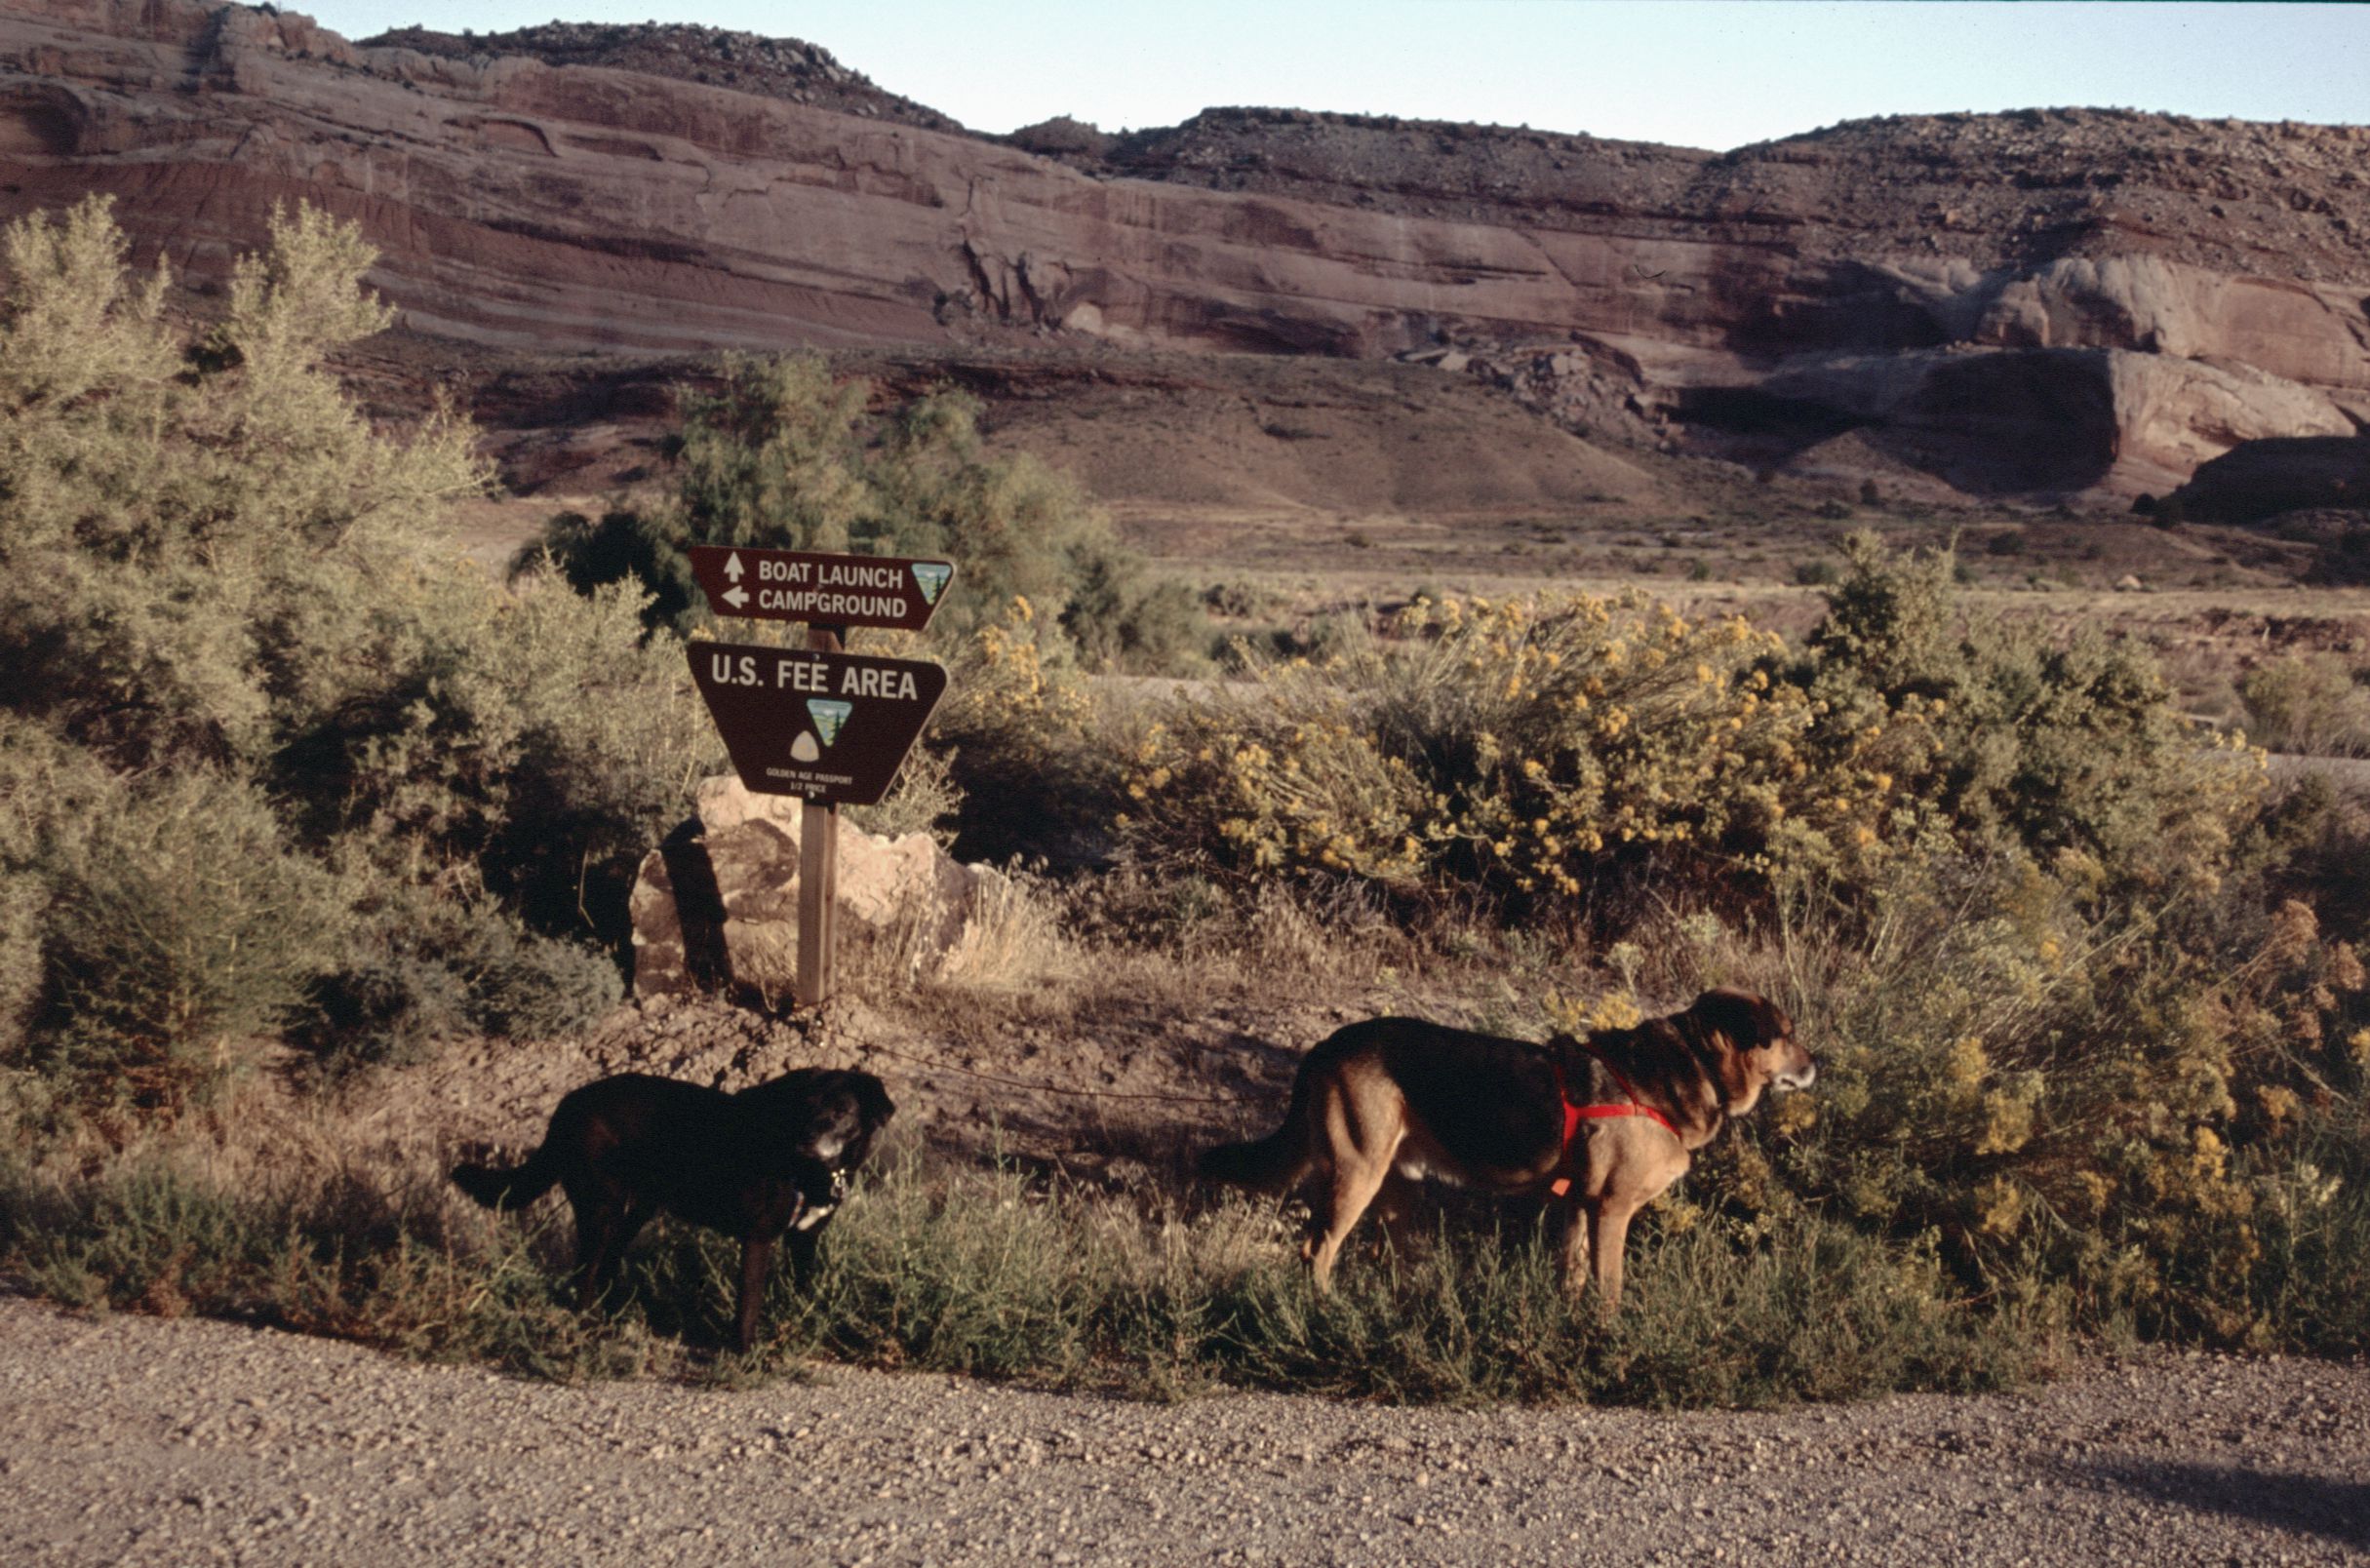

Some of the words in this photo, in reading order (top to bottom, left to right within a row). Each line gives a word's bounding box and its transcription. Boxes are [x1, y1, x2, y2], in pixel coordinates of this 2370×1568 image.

[759, 560, 811, 582] BOAT
[818, 565, 903, 589] LAUNCH
[759, 589, 907, 618] CAMPGROUND
[712, 653, 764, 686] U.S.
[777, 660, 829, 692] FEE
[841, 666, 918, 700] AREA
[798, 771, 812, 781] AGE
[815, 773, 852, 784] PASSPORT
